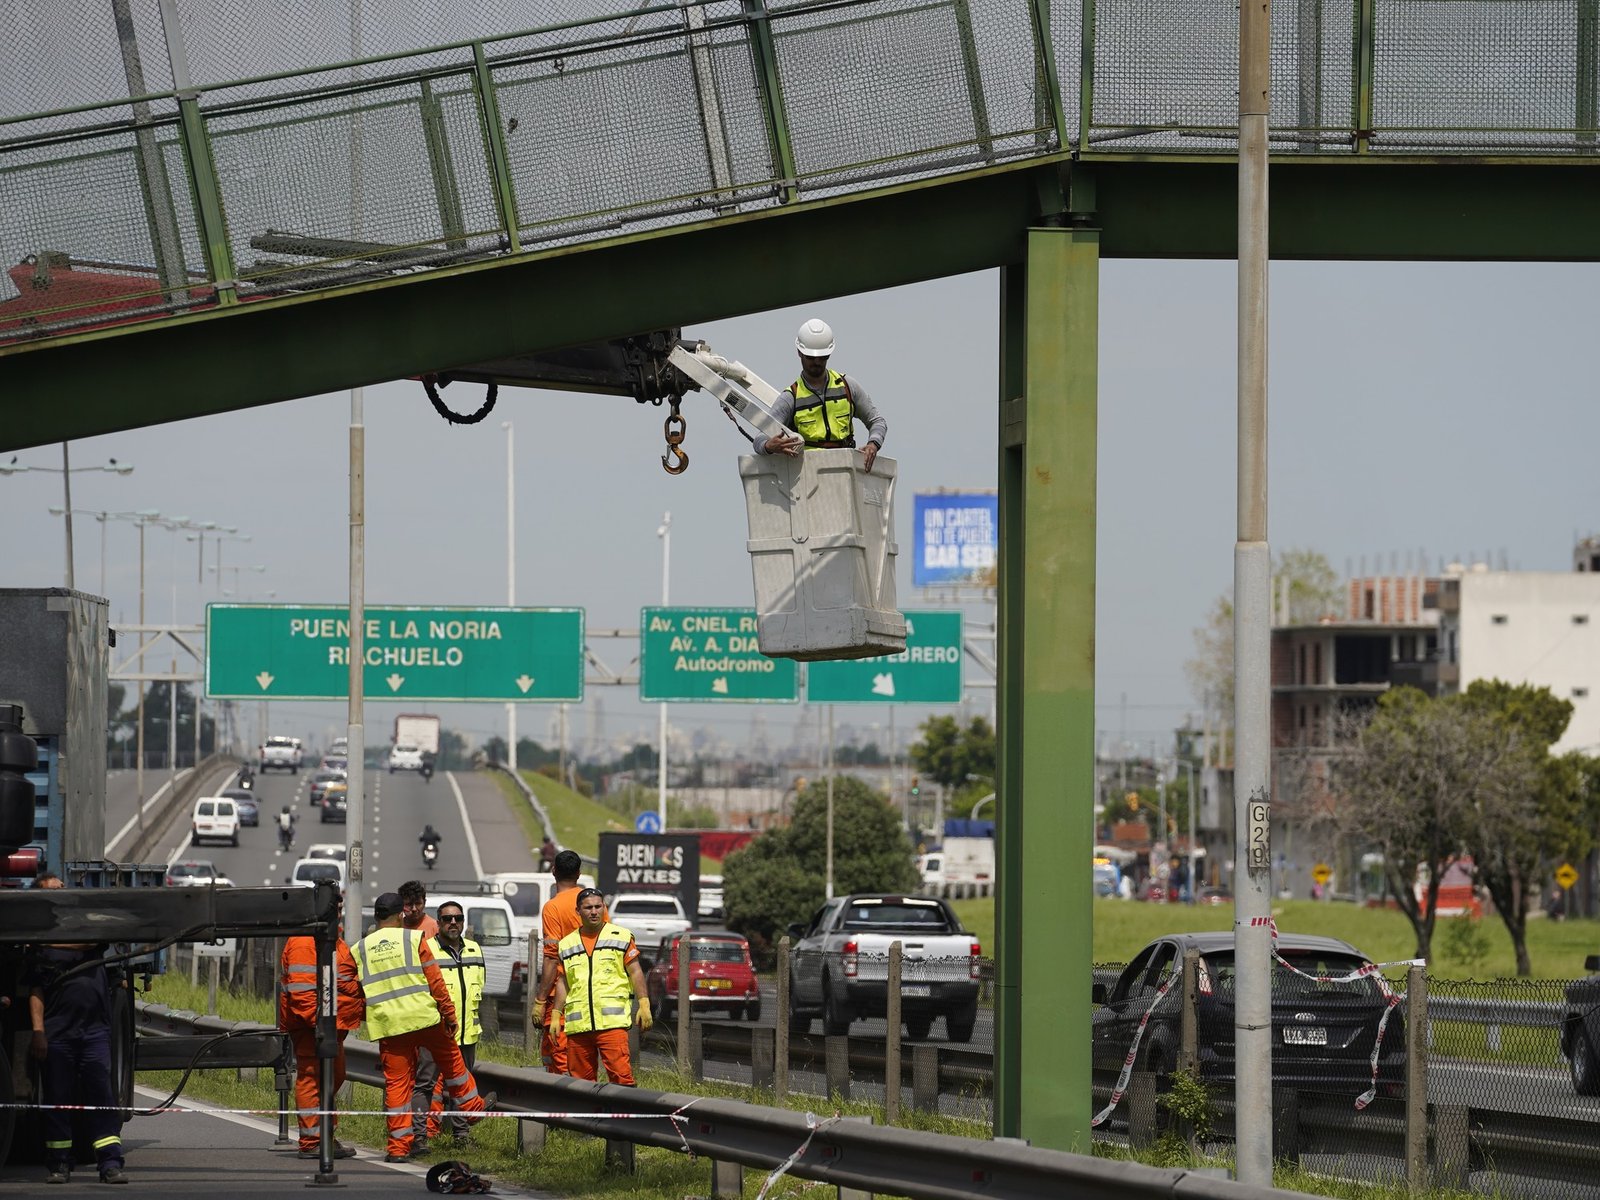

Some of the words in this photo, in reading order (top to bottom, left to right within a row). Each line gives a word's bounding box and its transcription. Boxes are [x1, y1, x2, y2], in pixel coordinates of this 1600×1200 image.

[290, 619, 381, 638] PUENE
[389, 620, 419, 639] LA
[429, 621, 502, 640] NORIA
[649, 617, 676, 632] Av.
[669, 636, 697, 652] Av.
[704, 637, 723, 652] A.
[328, 646, 463, 666] RICHUELO
[674, 655, 775, 673] Autodromo
[616, 868, 682, 884] AYRES
